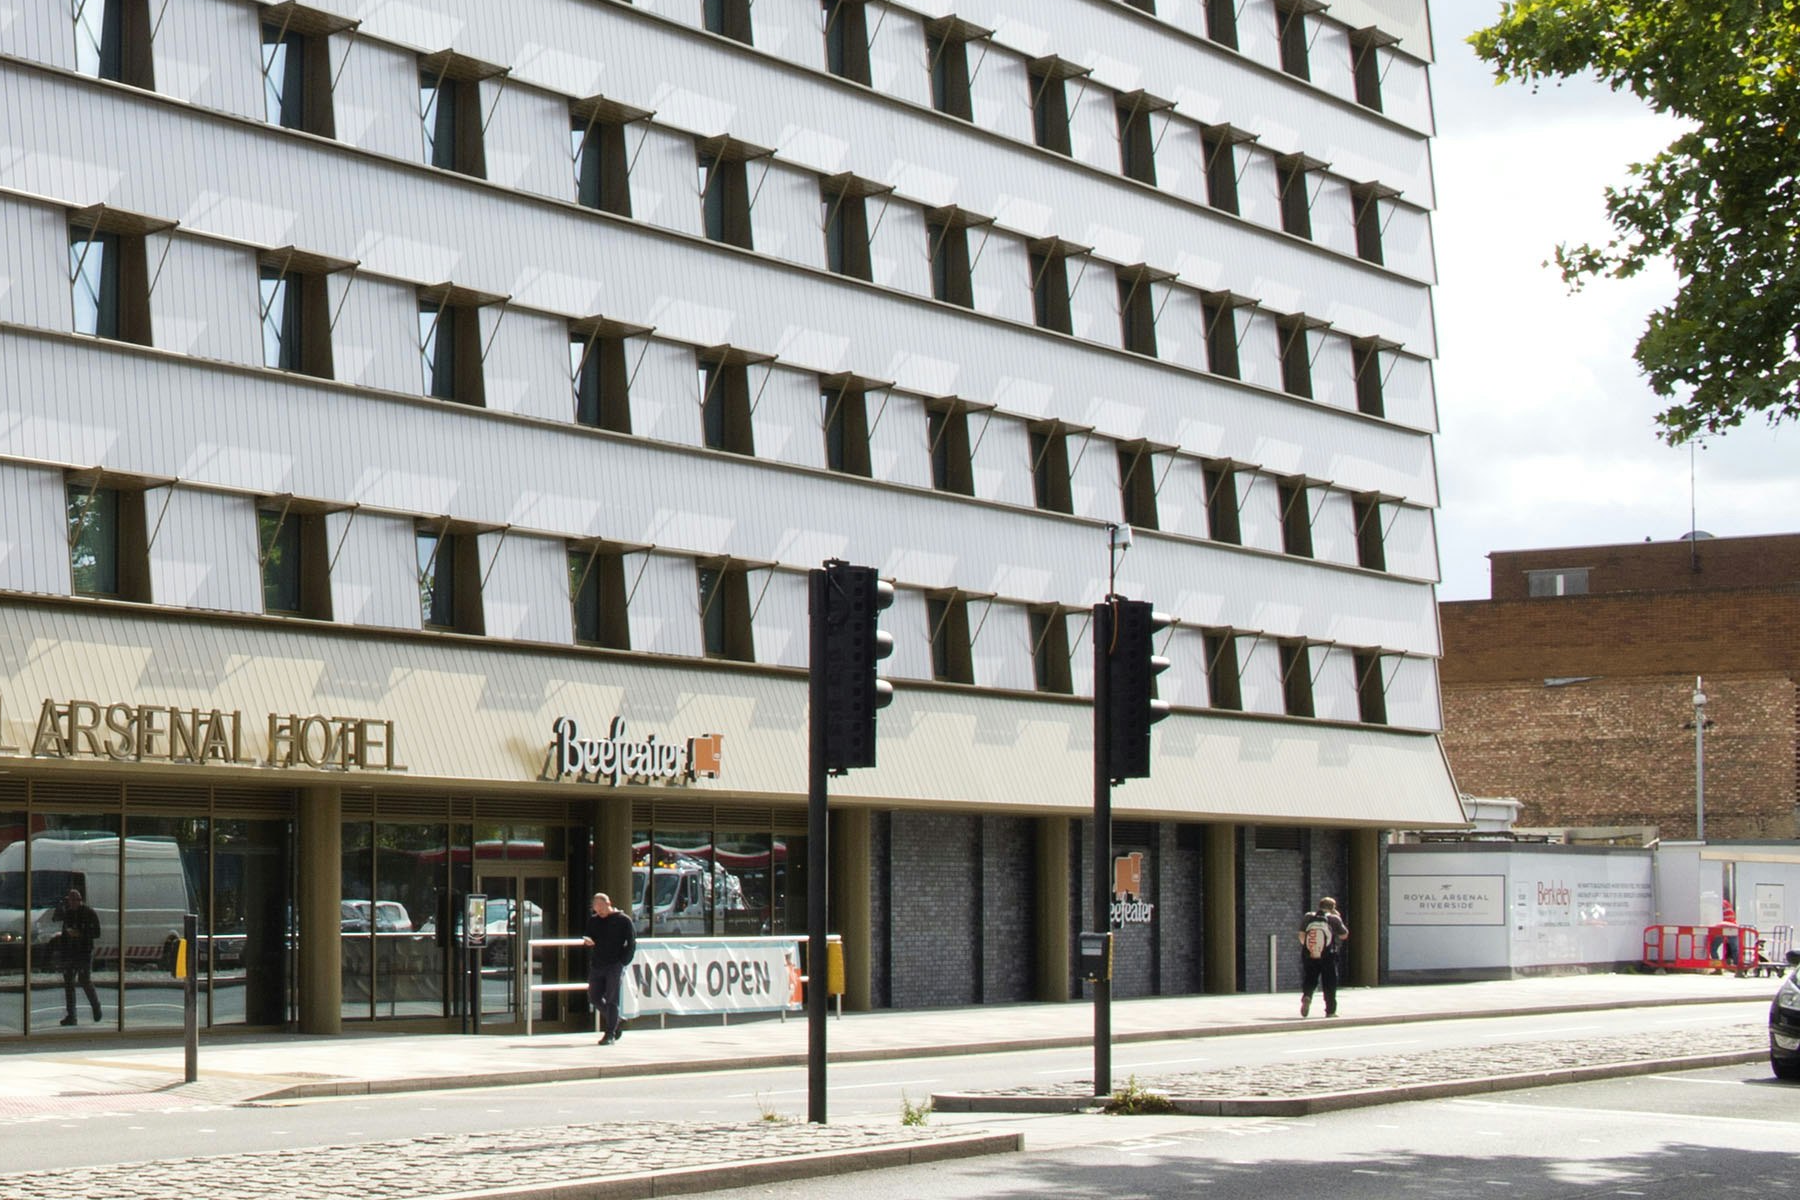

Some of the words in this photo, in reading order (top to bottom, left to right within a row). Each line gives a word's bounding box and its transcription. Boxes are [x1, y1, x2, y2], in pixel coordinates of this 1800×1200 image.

[31, 698, 256, 764] ARSENAL
[268, 712, 409, 771] HOTEL
[556, 714, 686, 788] Beefeater
[1110, 892, 1154, 929] eefeater
[1537, 880, 1572, 907] Berkeley
[632, 960, 698, 998] NOW
[706, 960, 771, 997] OPEN
